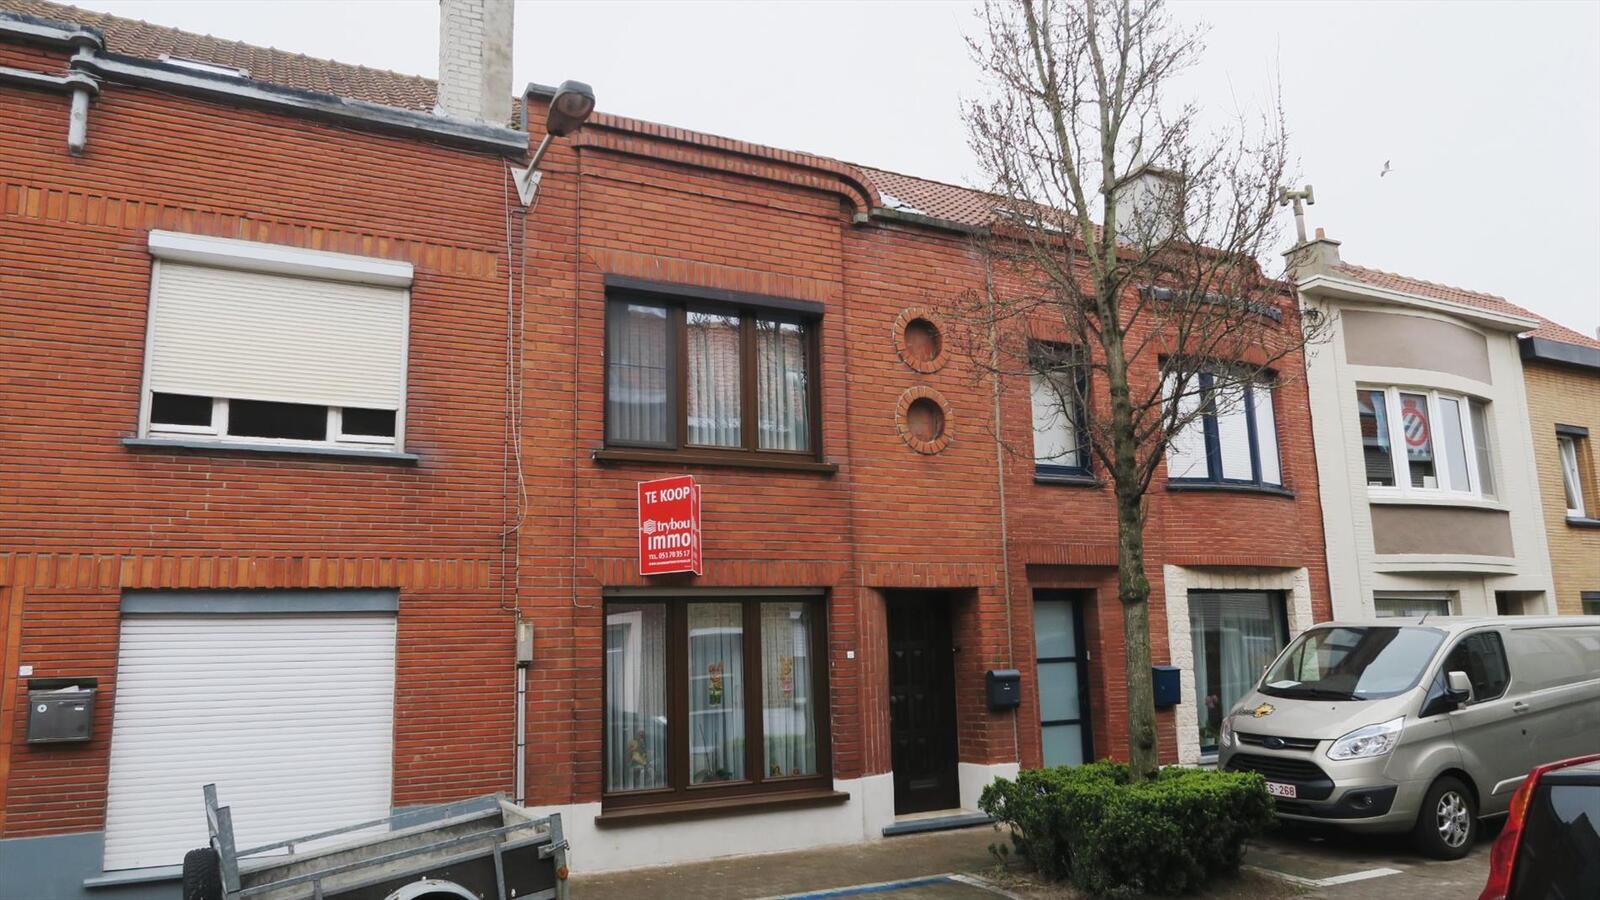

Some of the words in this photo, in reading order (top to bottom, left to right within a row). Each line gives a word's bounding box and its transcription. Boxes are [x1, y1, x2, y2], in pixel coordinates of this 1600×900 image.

[644, 491, 657, 504] TE
[660, 486, 690, 502] KOOP
[657, 517, 690, 534] trybou
